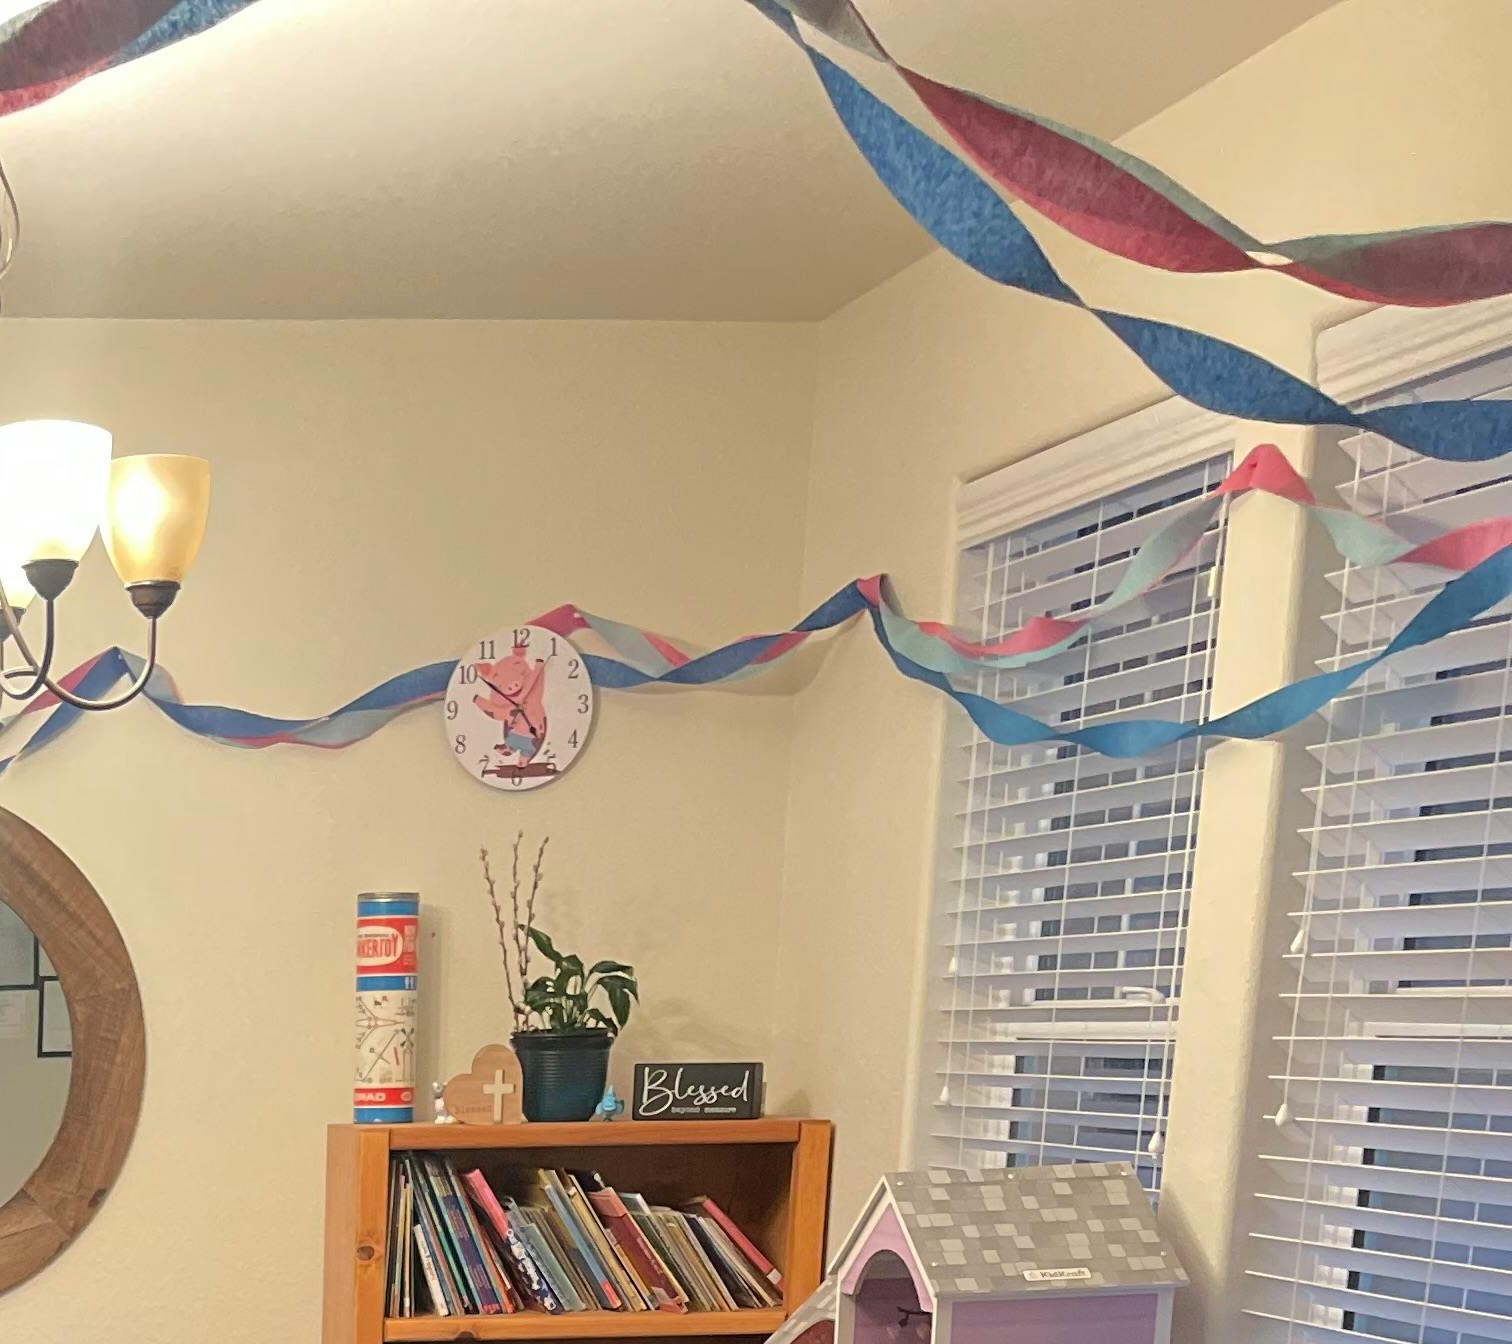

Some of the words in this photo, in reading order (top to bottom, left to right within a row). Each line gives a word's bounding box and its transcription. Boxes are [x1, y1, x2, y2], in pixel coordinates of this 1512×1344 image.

[512, 628, 531, 648] 12
[550, 637, 558, 656] 1
[479, 640, 496, 659] 11
[458, 664, 478, 684] 10
[568, 660, 580, 679] 2
[447, 701, 458, 720] 9
[578, 694, 589, 714] 3
[455, 735, 466, 754] 8
[568, 730, 578, 748] 4
[639, 1067, 750, 1116] Blessed
